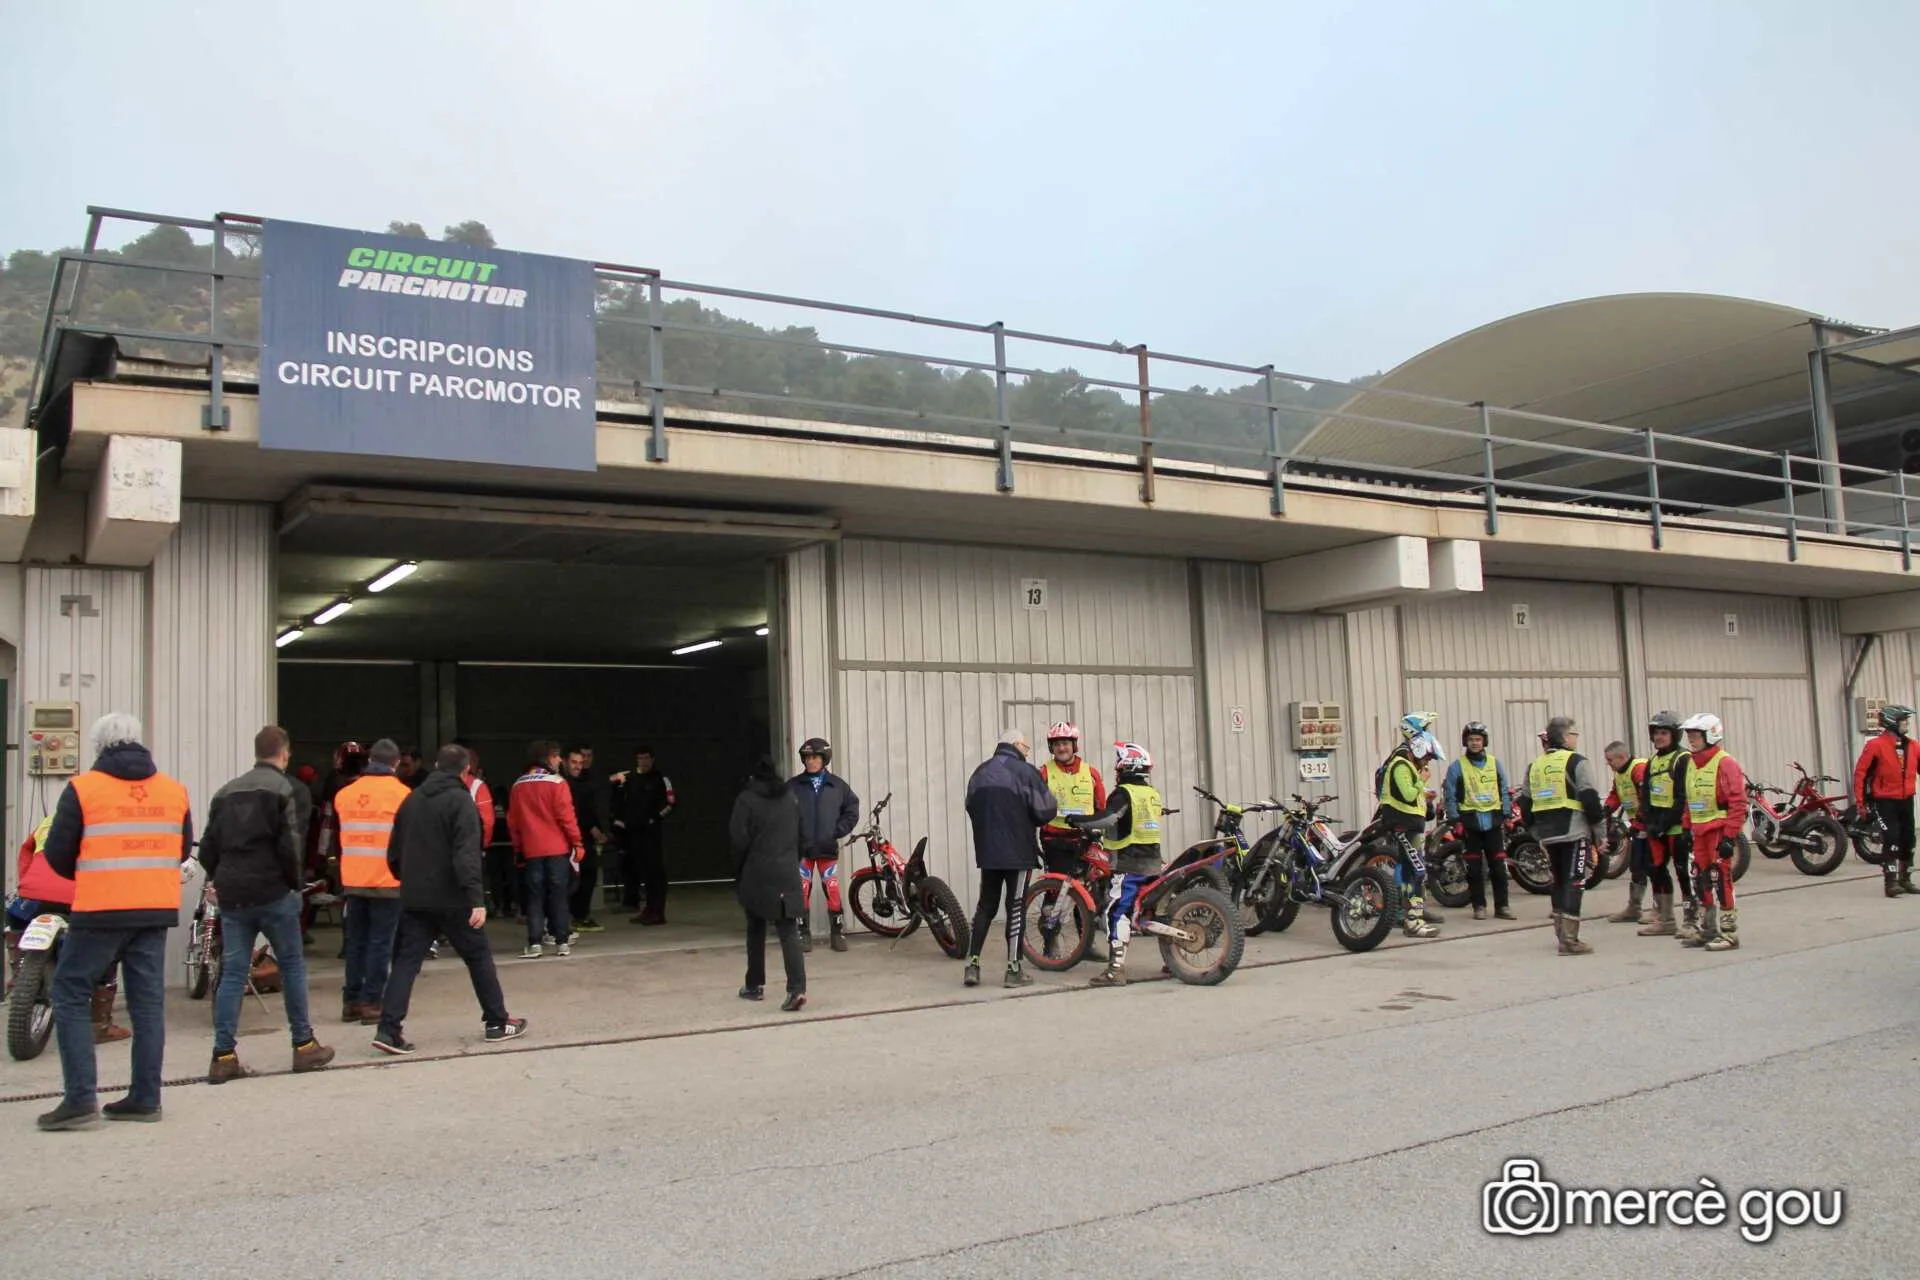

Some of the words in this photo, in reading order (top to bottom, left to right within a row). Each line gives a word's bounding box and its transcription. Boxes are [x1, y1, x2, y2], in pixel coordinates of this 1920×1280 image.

[348, 247, 498, 282] CIRCUIT
[338, 268, 527, 308] PARCMOTOR
[327, 331, 534, 373] INSCRIPCIONS
[277, 360, 403, 393] CIRCUIT
[409, 371, 581, 409] PARCMOTOR
[1026, 588, 1042, 605] 13
[1516, 611, 1526, 625] 12
[1728, 621, 1735, 633] 11
[1301, 762, 1328, 774] 13-12
